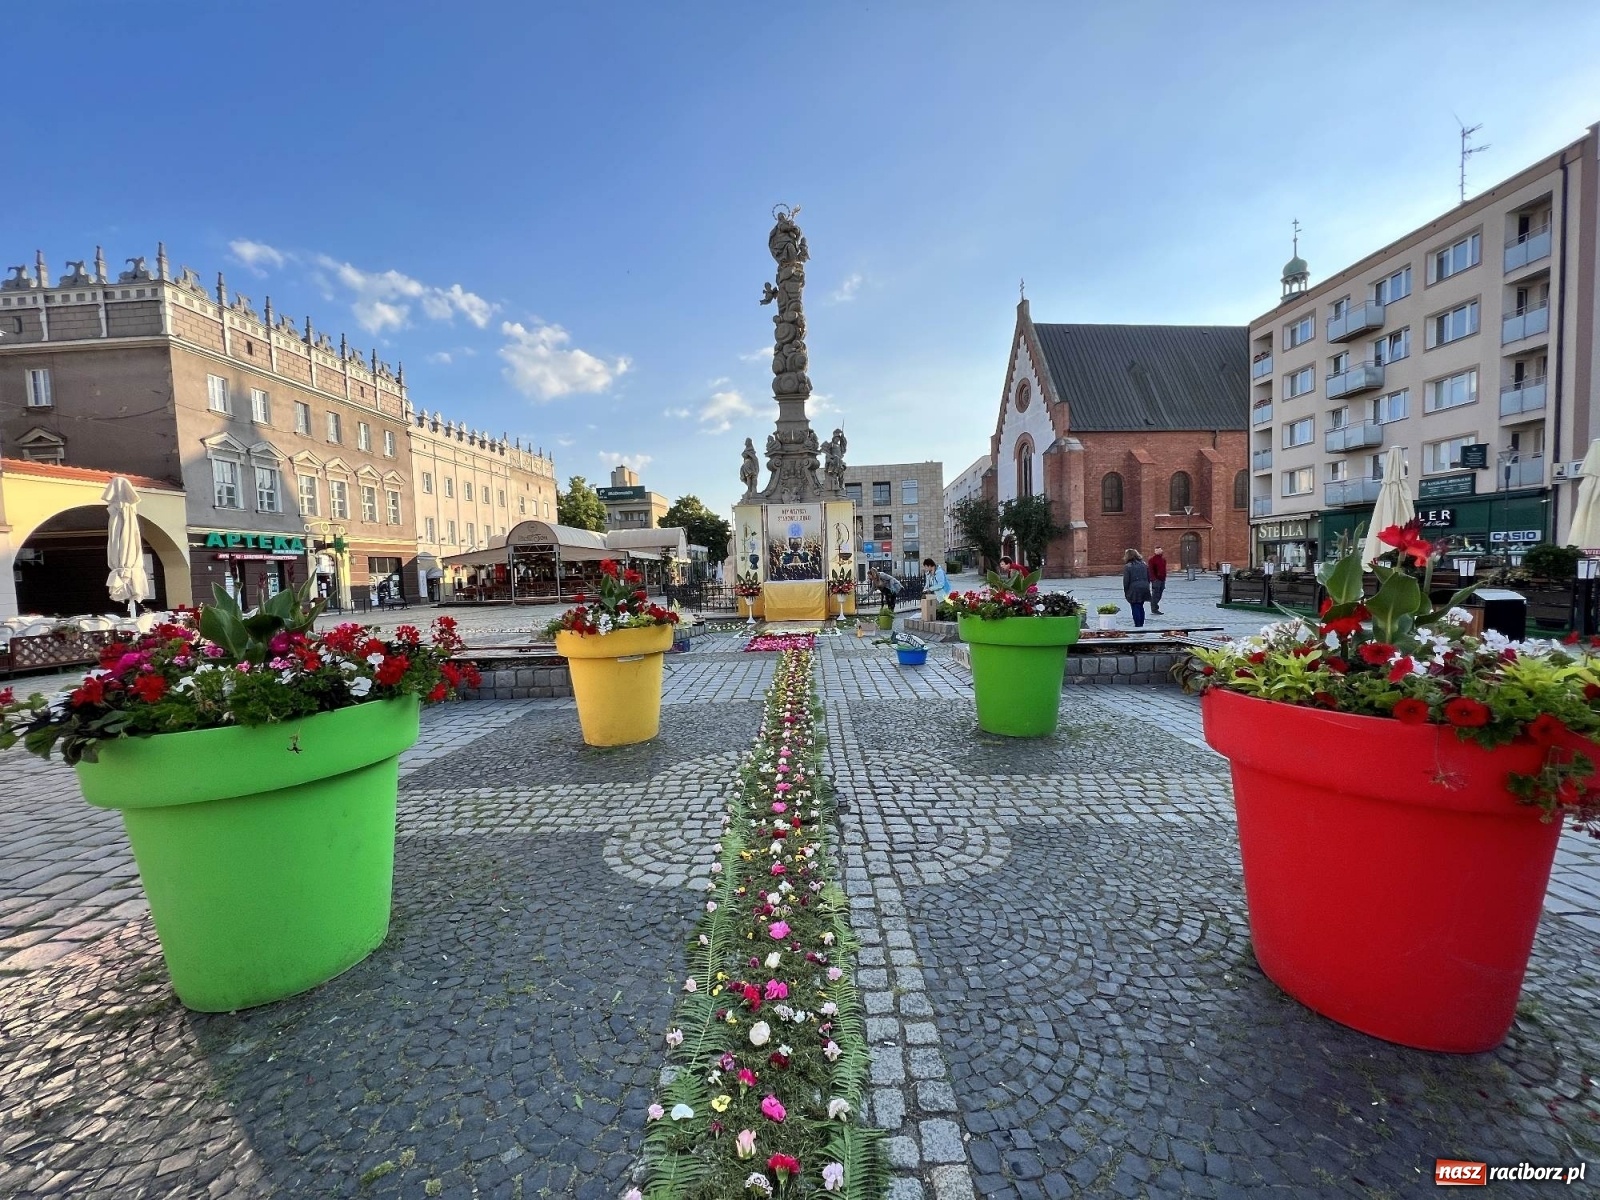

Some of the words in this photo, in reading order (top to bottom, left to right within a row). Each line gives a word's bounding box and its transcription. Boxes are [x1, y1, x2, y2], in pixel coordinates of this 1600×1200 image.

[1258, 525, 1304, 538] STELLA
[1492, 531, 1537, 541] CASIO
[206, 532, 304, 549] APTEKA
